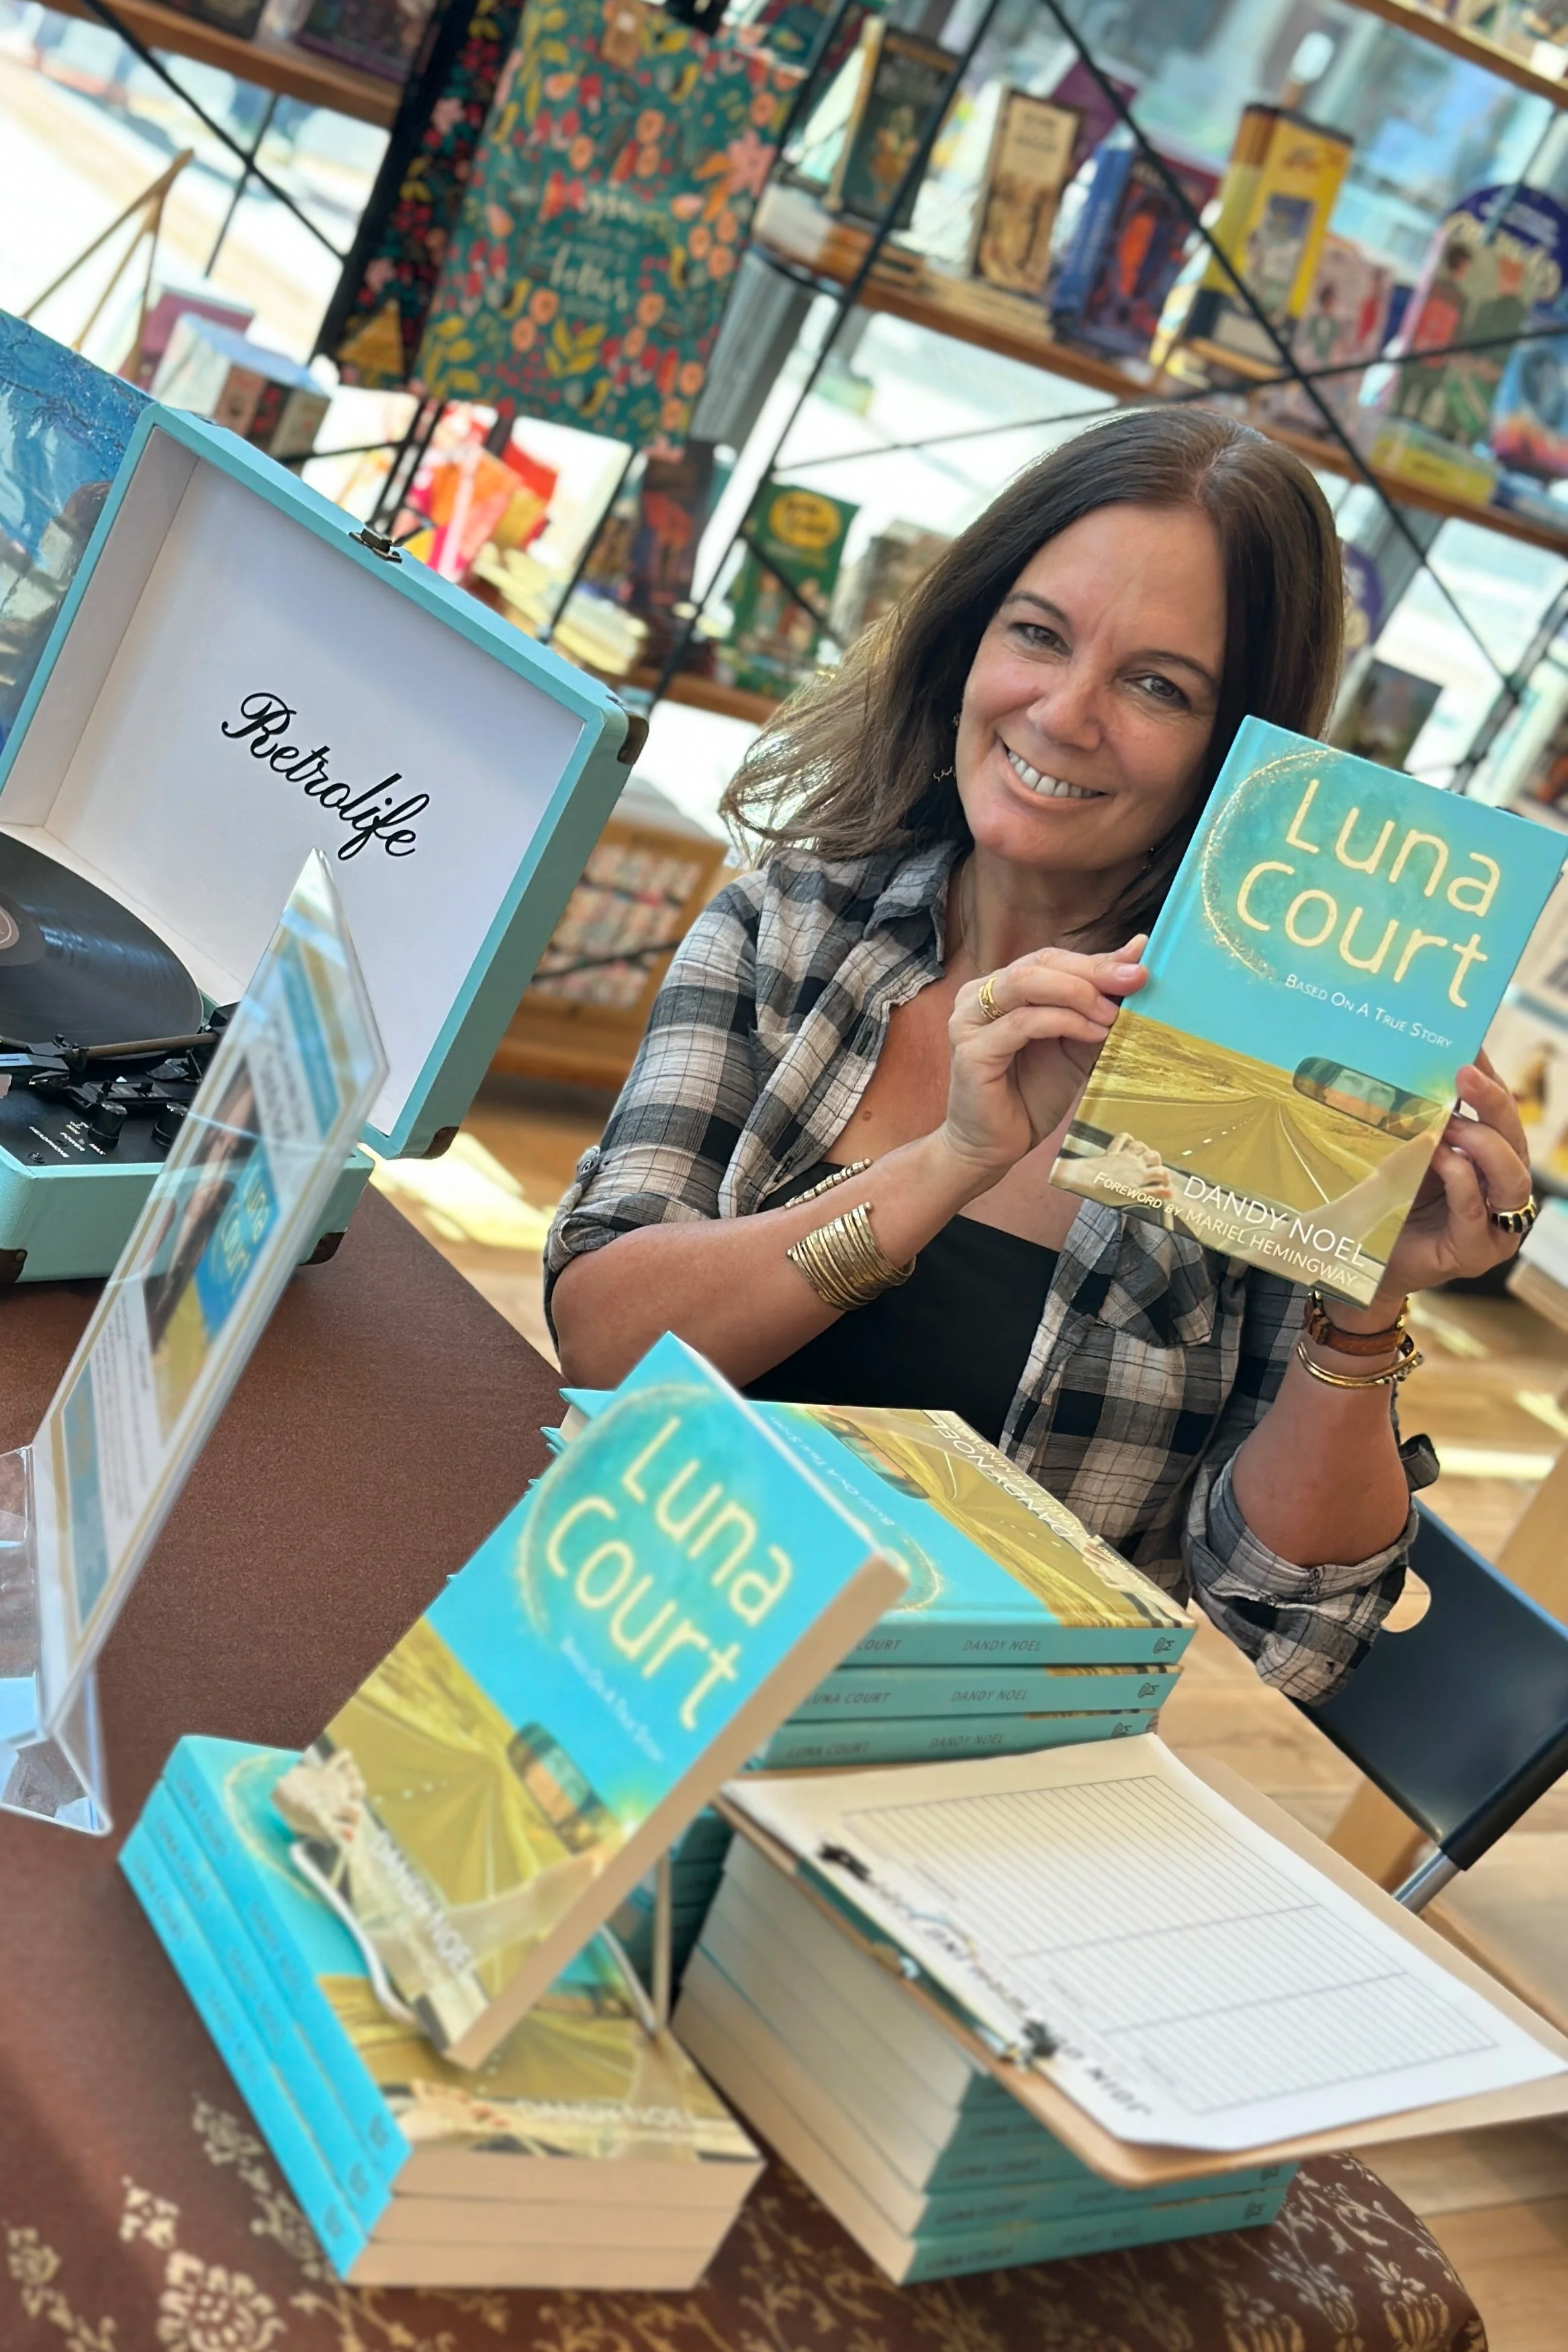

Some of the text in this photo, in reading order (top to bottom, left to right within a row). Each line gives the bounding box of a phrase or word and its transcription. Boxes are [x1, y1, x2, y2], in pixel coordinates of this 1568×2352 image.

[221, 692, 430, 860] Retrolife
[1285, 779, 1500, 917] Luna
[1237, 861, 1488, 1007] Court
[1356, 1003, 1369, 1017] A
[1094, 1171, 1162, 1209] FOREWORD
[1185, 1208, 1246, 1243] MARIEL
[1250, 1234, 1358, 1287] HEMINGWAY
[1183, 1175, 1365, 1267] DANDY NOEL
[621, 1416, 792, 1627] Luna
[931, 1424, 1074, 1537] DANDY NOEL
[546, 1495, 741, 1731] Court
[856, 1639, 1042, 1652] COURT DANDY NOEL
[844, 1692, 890, 1704] COURT
[951, 1691, 995, 1703] DANDY
[996, 1690, 1028, 1701] NOEL
